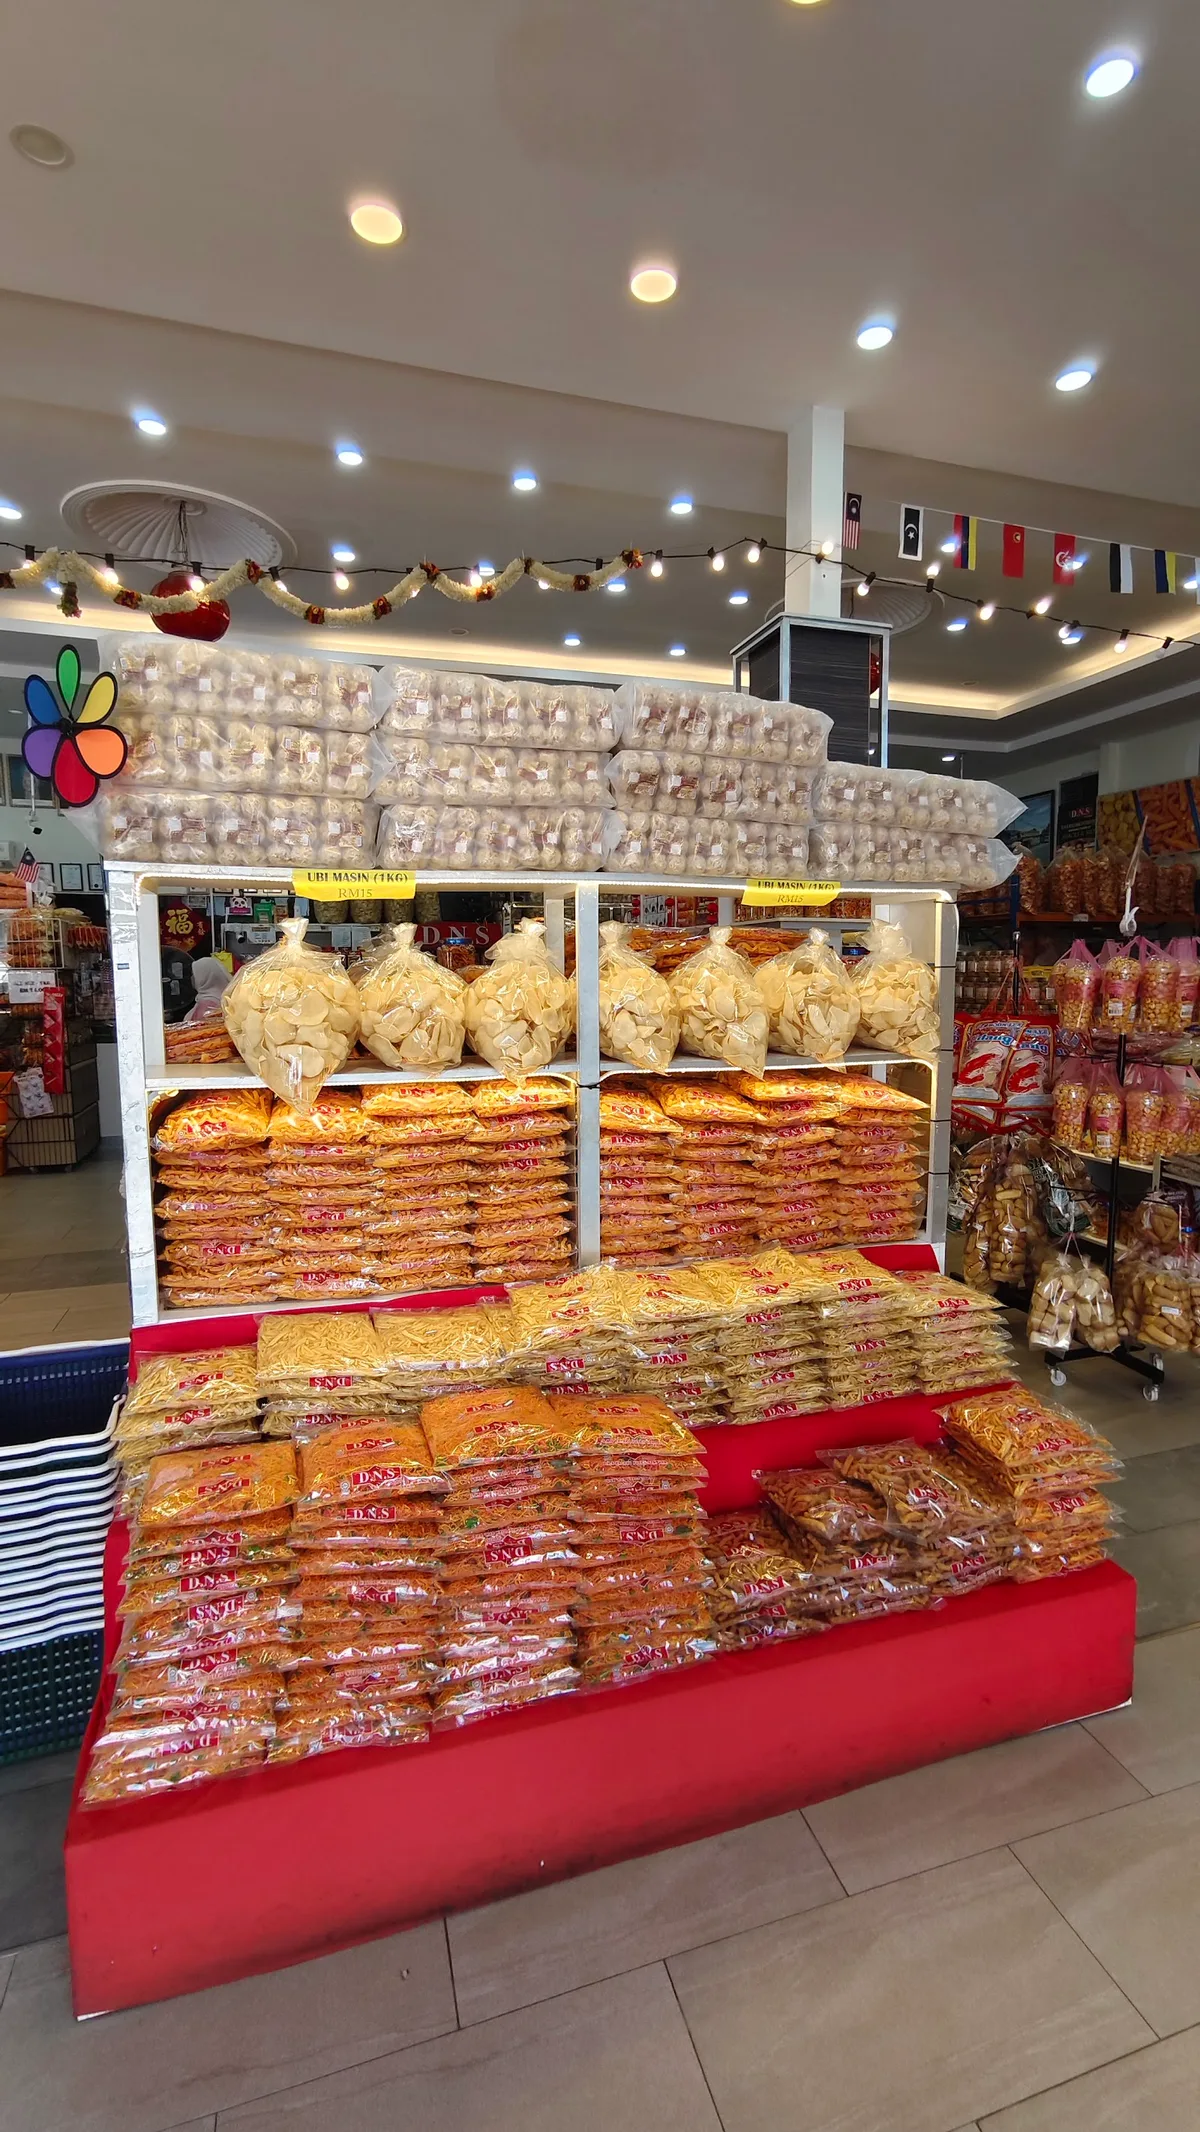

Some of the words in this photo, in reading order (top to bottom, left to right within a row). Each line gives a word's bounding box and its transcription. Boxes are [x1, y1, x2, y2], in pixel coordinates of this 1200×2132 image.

[308, 872, 328, 882] UBI
[333, 872, 369, 883] MASIN
[374, 872, 408, 884] (1KG)
[777, 882, 806, 890] MASIN
[338, 888, 373, 898] RM15
[777, 894, 804, 903] RM15
[165, 909, 194, 935] 福
[614, 1136, 641, 1144] D.N.S
[307, 1273, 337, 1281] D.N.S
[657, 1354, 685, 1364] D.N.S
[550, 1361, 579, 1371] D.N.S
[314, 1377, 346, 1388] D.N.S
[556, 1385, 586, 1395] D.N.S
[171, 1410, 206, 1424] D.N.S
[769, 1406, 793, 1417] D.N.S
[311, 1413, 344, 1424] D.N.S
[359, 1468, 396, 1483] D.N.S
[204, 1477, 243, 1494] D.N.S
[353, 1508, 390, 1519] D.N.S
[626, 1529, 658, 1541] D.N.S
[190, 1547, 231, 1563] D.N.S
[490, 1547, 524, 1562] D.N.S
[189, 1573, 231, 1587] D.N.S
[750, 1579, 781, 1594] D.N.S
[195, 1599, 236, 1621] D.N.S
[188, 1651, 231, 1670] D.N.S
[631, 1648, 663, 1662] D.N.S
